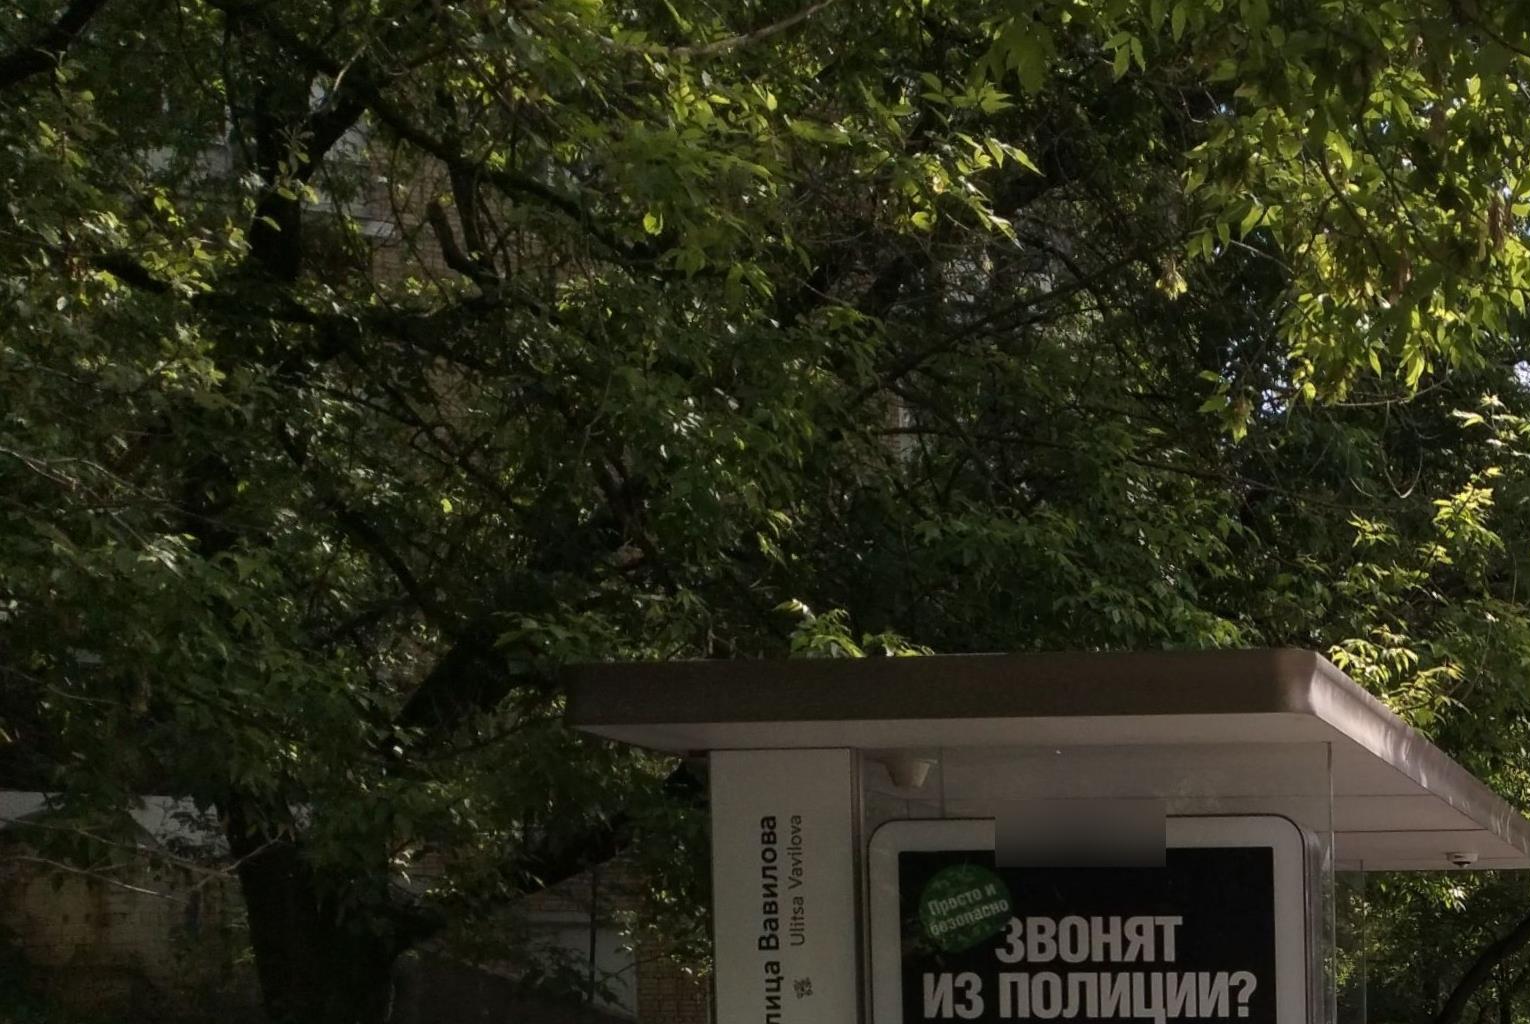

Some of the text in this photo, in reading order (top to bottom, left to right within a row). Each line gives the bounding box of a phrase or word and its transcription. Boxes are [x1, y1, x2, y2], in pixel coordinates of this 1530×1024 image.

[758, 815, 779, 950] Вавилова
[787, 815, 805, 946] Ulitsa Vavilova
[927, 884, 997, 915] Просто и
[928, 899, 1009, 937] безопасно
[995, 915, 1183, 963] ЗВОНЯТ
[923, 972, 984, 1019] ИЗ
